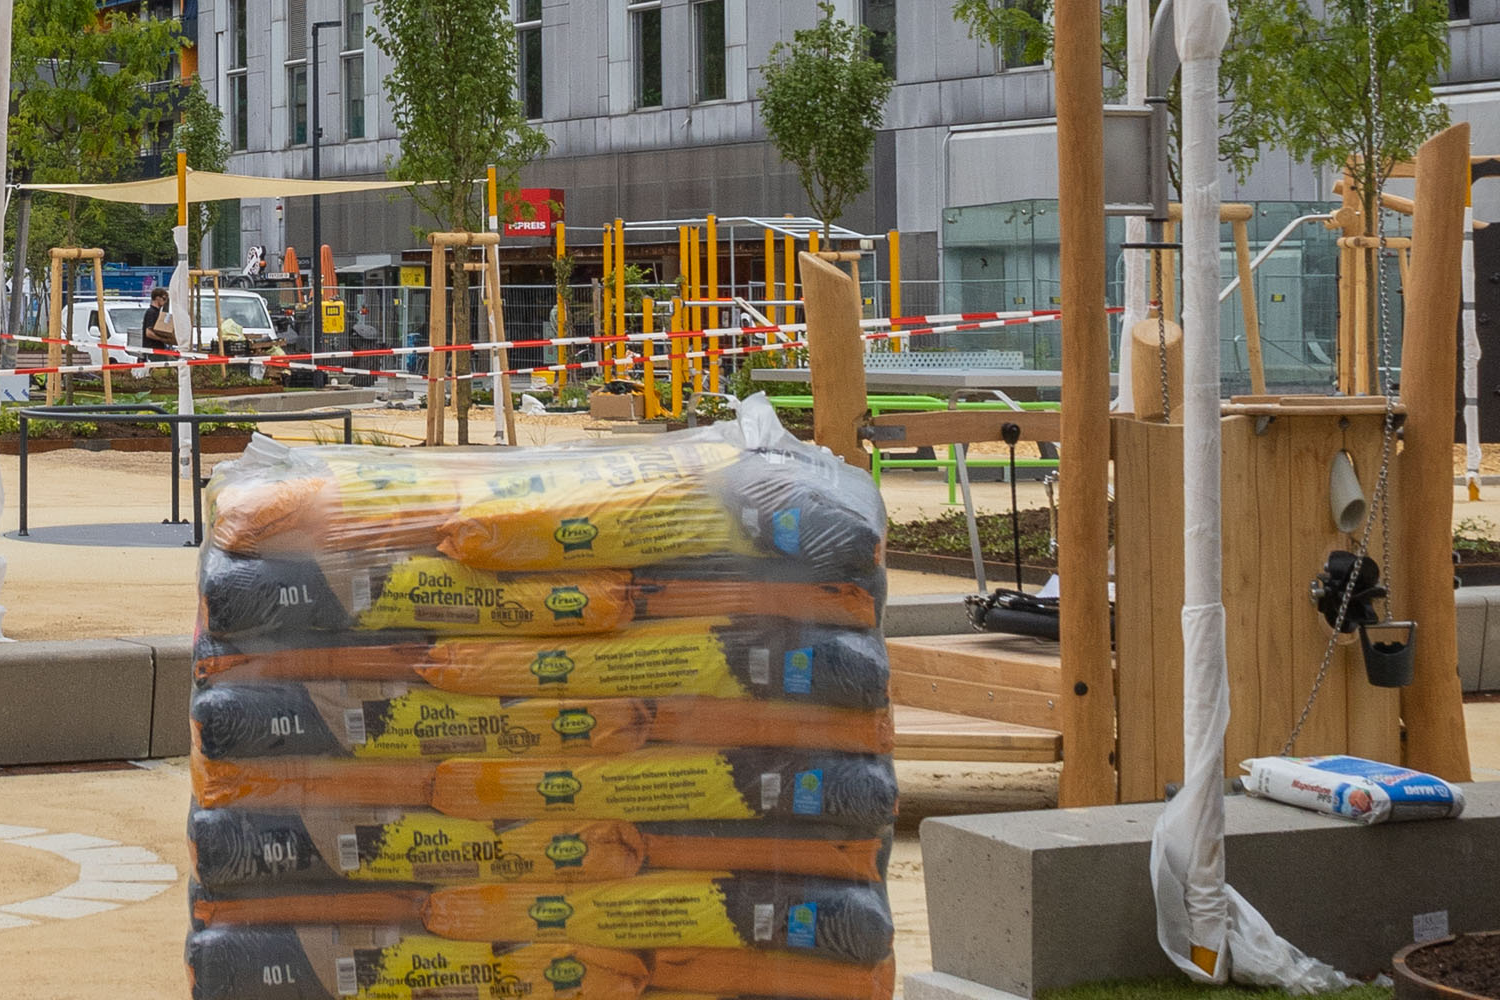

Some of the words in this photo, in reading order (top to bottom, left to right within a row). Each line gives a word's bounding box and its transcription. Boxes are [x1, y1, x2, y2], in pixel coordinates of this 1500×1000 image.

[418, 571, 455, 588] Dach-
[278, 585, 300, 608] 40
[303, 584, 313, 603] L
[420, 704, 459, 721] Dach-
[270, 716, 291, 736] 40
[293, 714, 304, 734] L
[414, 830, 452, 847] Dach-
[264, 842, 283, 863] 40
[286, 841, 297, 860] L
[412, 953, 450, 971] Dach-
[263, 966, 283, 986] 40
[285, 964, 296, 984] L
